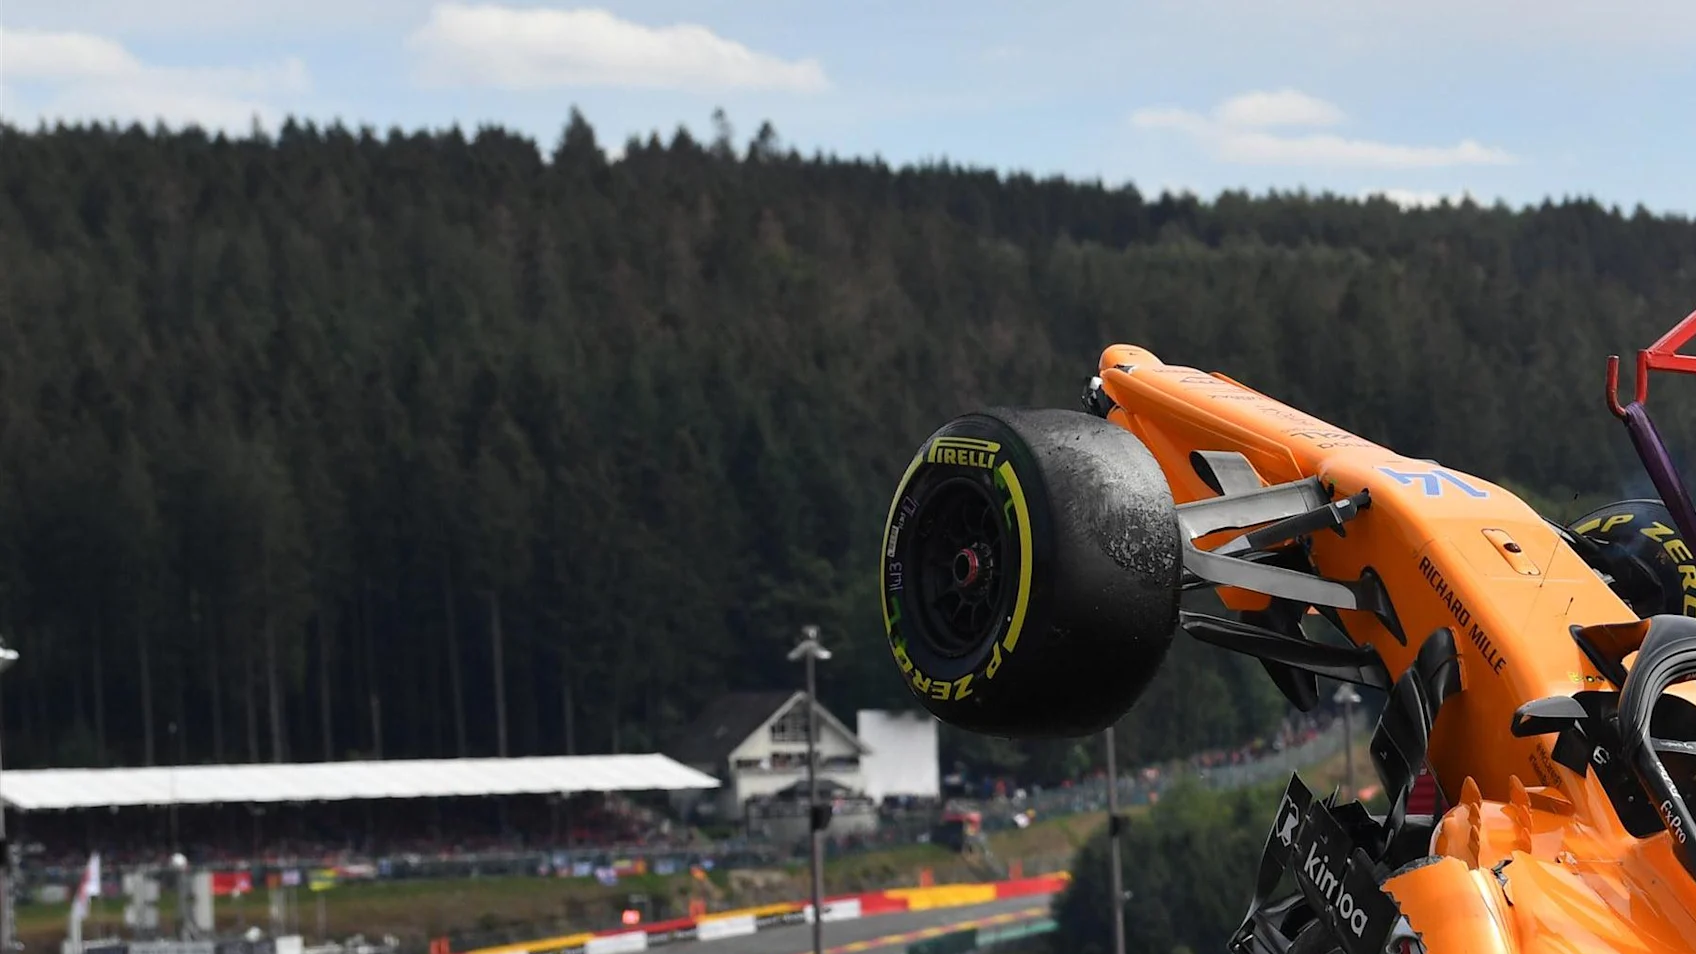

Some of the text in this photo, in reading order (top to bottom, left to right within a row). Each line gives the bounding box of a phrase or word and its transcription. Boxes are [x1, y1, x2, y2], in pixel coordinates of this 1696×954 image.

[928, 437, 1001, 469] PIRELLI
[1600, 513, 1635, 533] P
[1418, 556, 1507, 675] RICHARD MILLE
